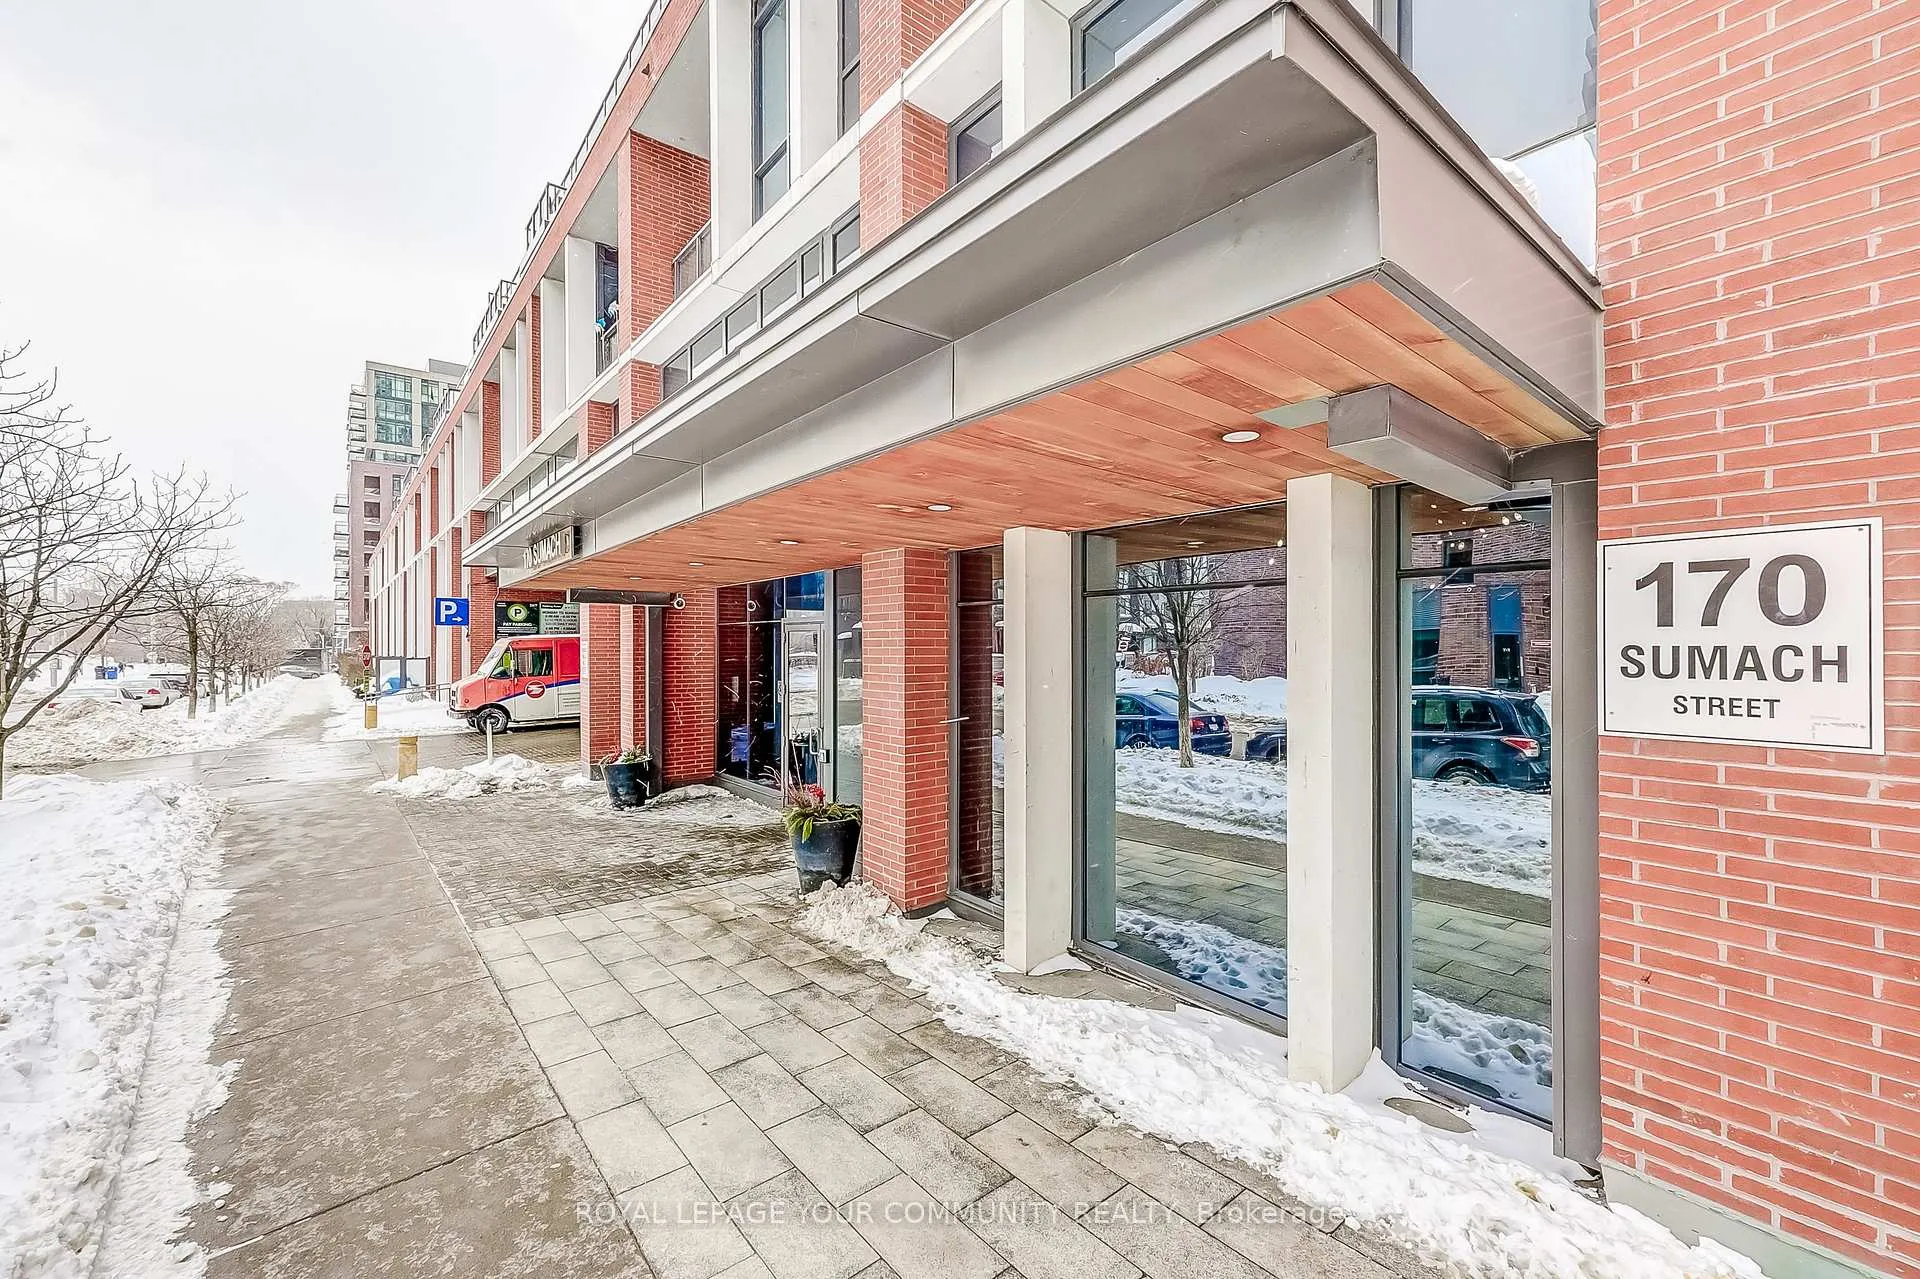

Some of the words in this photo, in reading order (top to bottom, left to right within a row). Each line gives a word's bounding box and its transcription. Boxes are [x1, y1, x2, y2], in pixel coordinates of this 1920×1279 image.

[533, 532, 561, 565] SUMACH
[1635, 554, 1827, 627] 170
[440, 601, 458, 622] P
[514, 608, 522, 617] P
[1620, 644, 1848, 683] SUMACH
[1673, 695, 1781, 719] STREET
